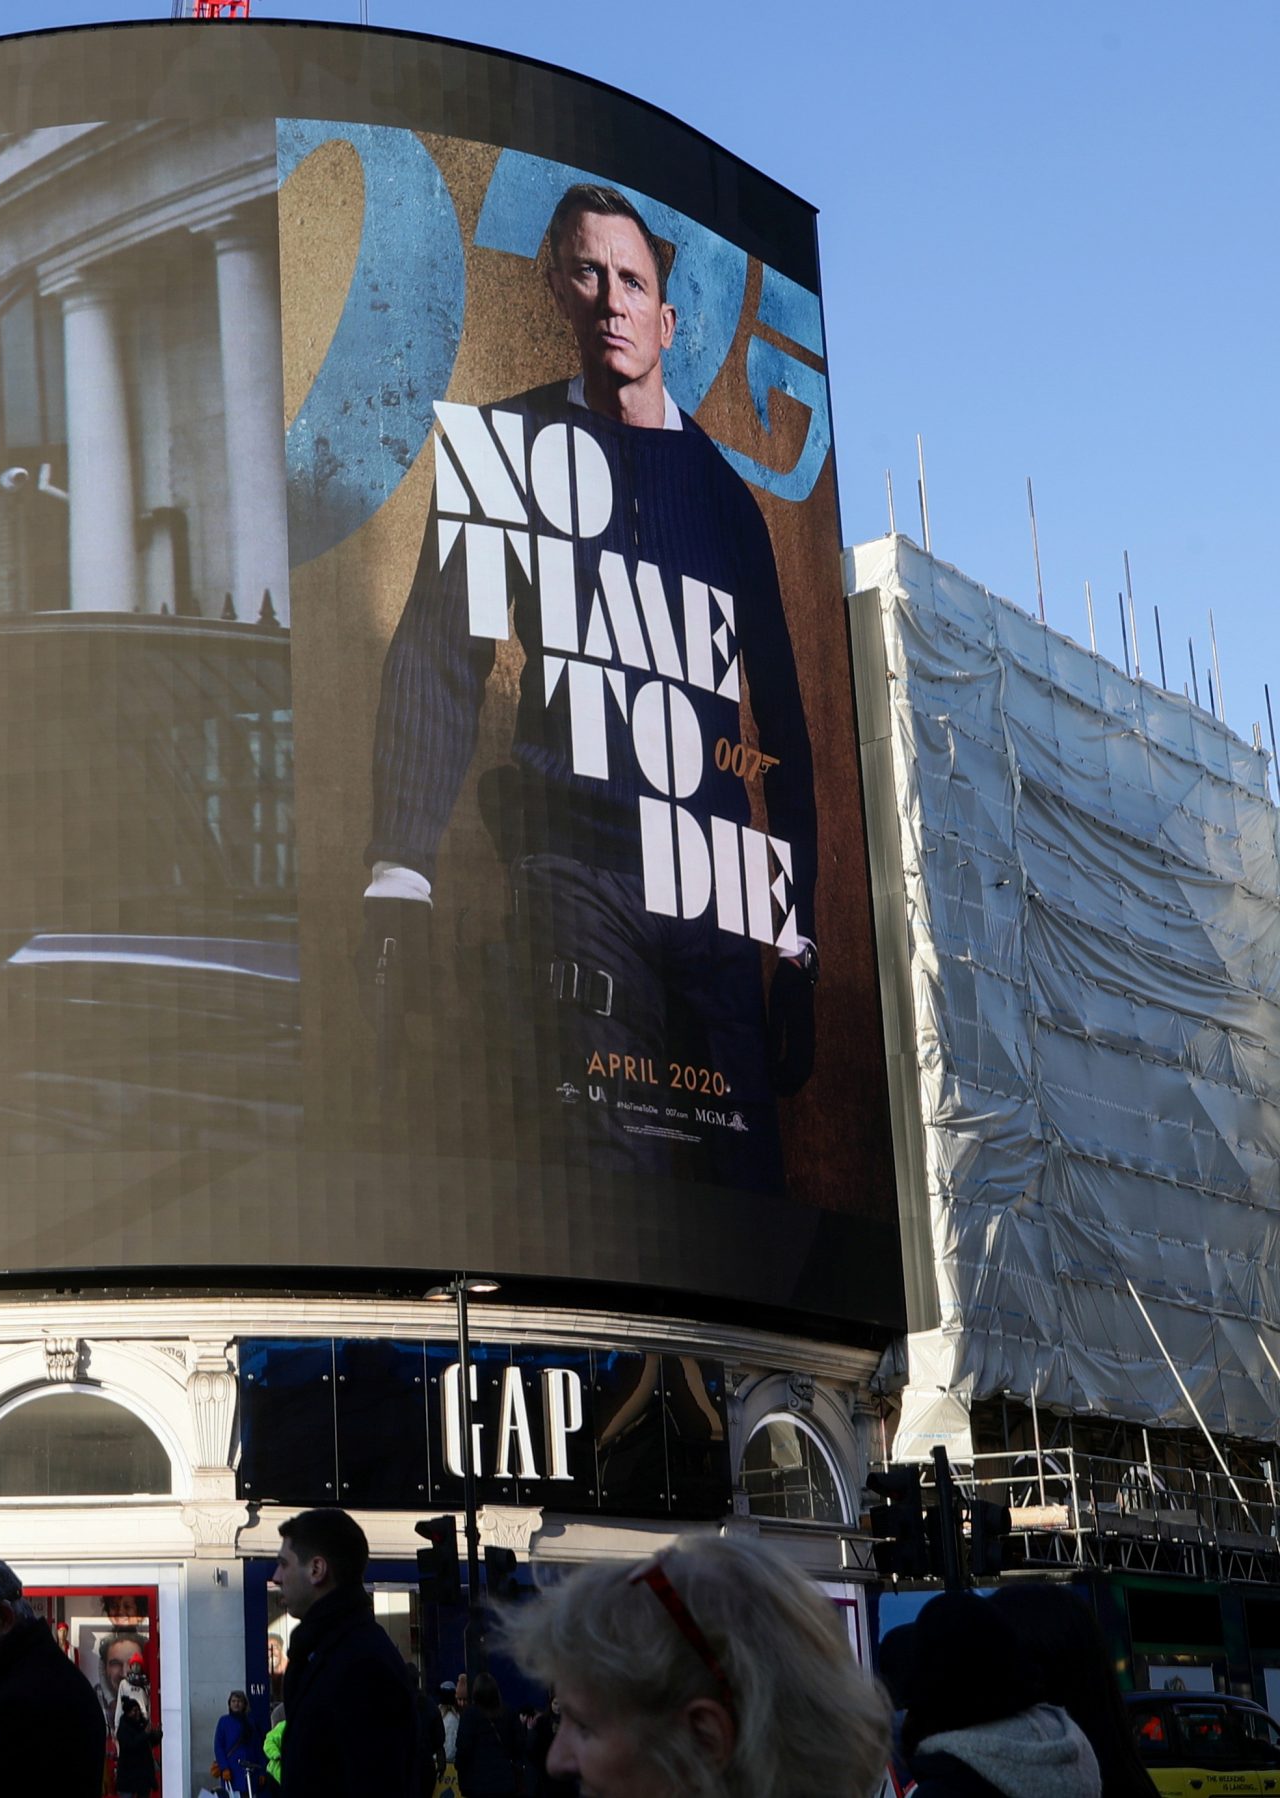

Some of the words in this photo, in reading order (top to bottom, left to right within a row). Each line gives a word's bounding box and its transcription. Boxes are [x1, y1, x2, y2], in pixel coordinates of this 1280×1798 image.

[432, 399, 614, 540] NO
[437, 518, 741, 703] TIME
[543, 655, 704, 799] TO
[714, 737, 780, 782] 007
[639, 796, 799, 955] DIE
[587, 1050, 658, 1085] APRIL
[669, 1063, 726, 1097] 2020
[694, 1107, 727, 1127] MGM
[440, 1362, 583, 1481] GAP
[250, 1683, 266, 1696] GAP
